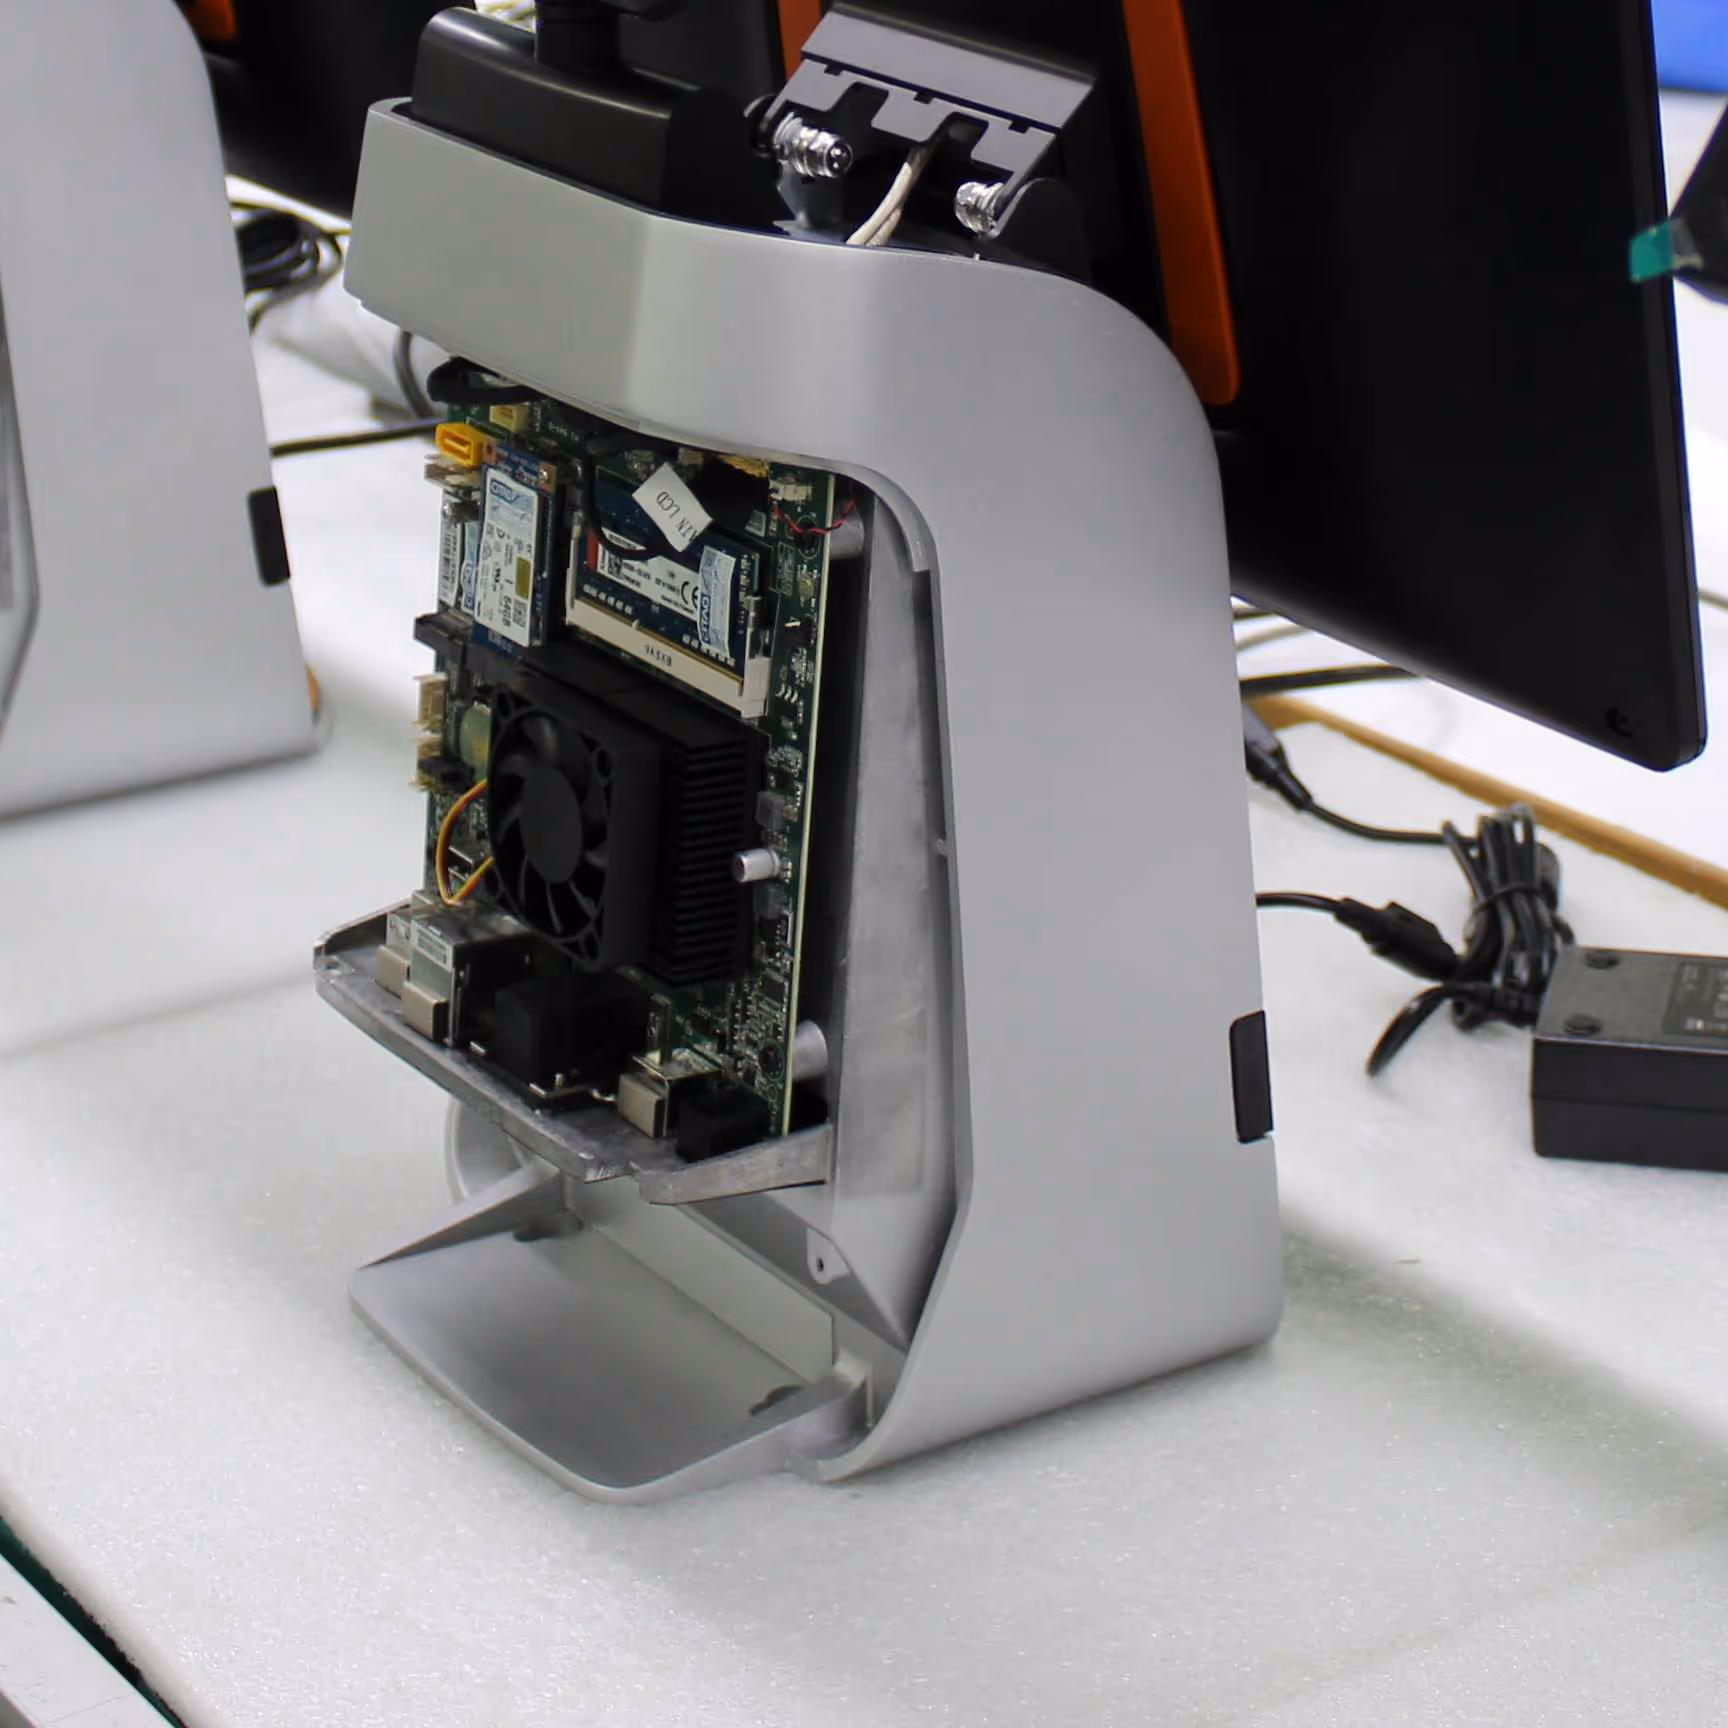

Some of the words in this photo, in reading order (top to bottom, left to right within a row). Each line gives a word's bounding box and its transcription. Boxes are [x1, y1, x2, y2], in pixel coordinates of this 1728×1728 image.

[656, 490, 681, 518] LCD
[675, 517, 699, 544] AIN
[502, 594, 513, 628] 64GB
